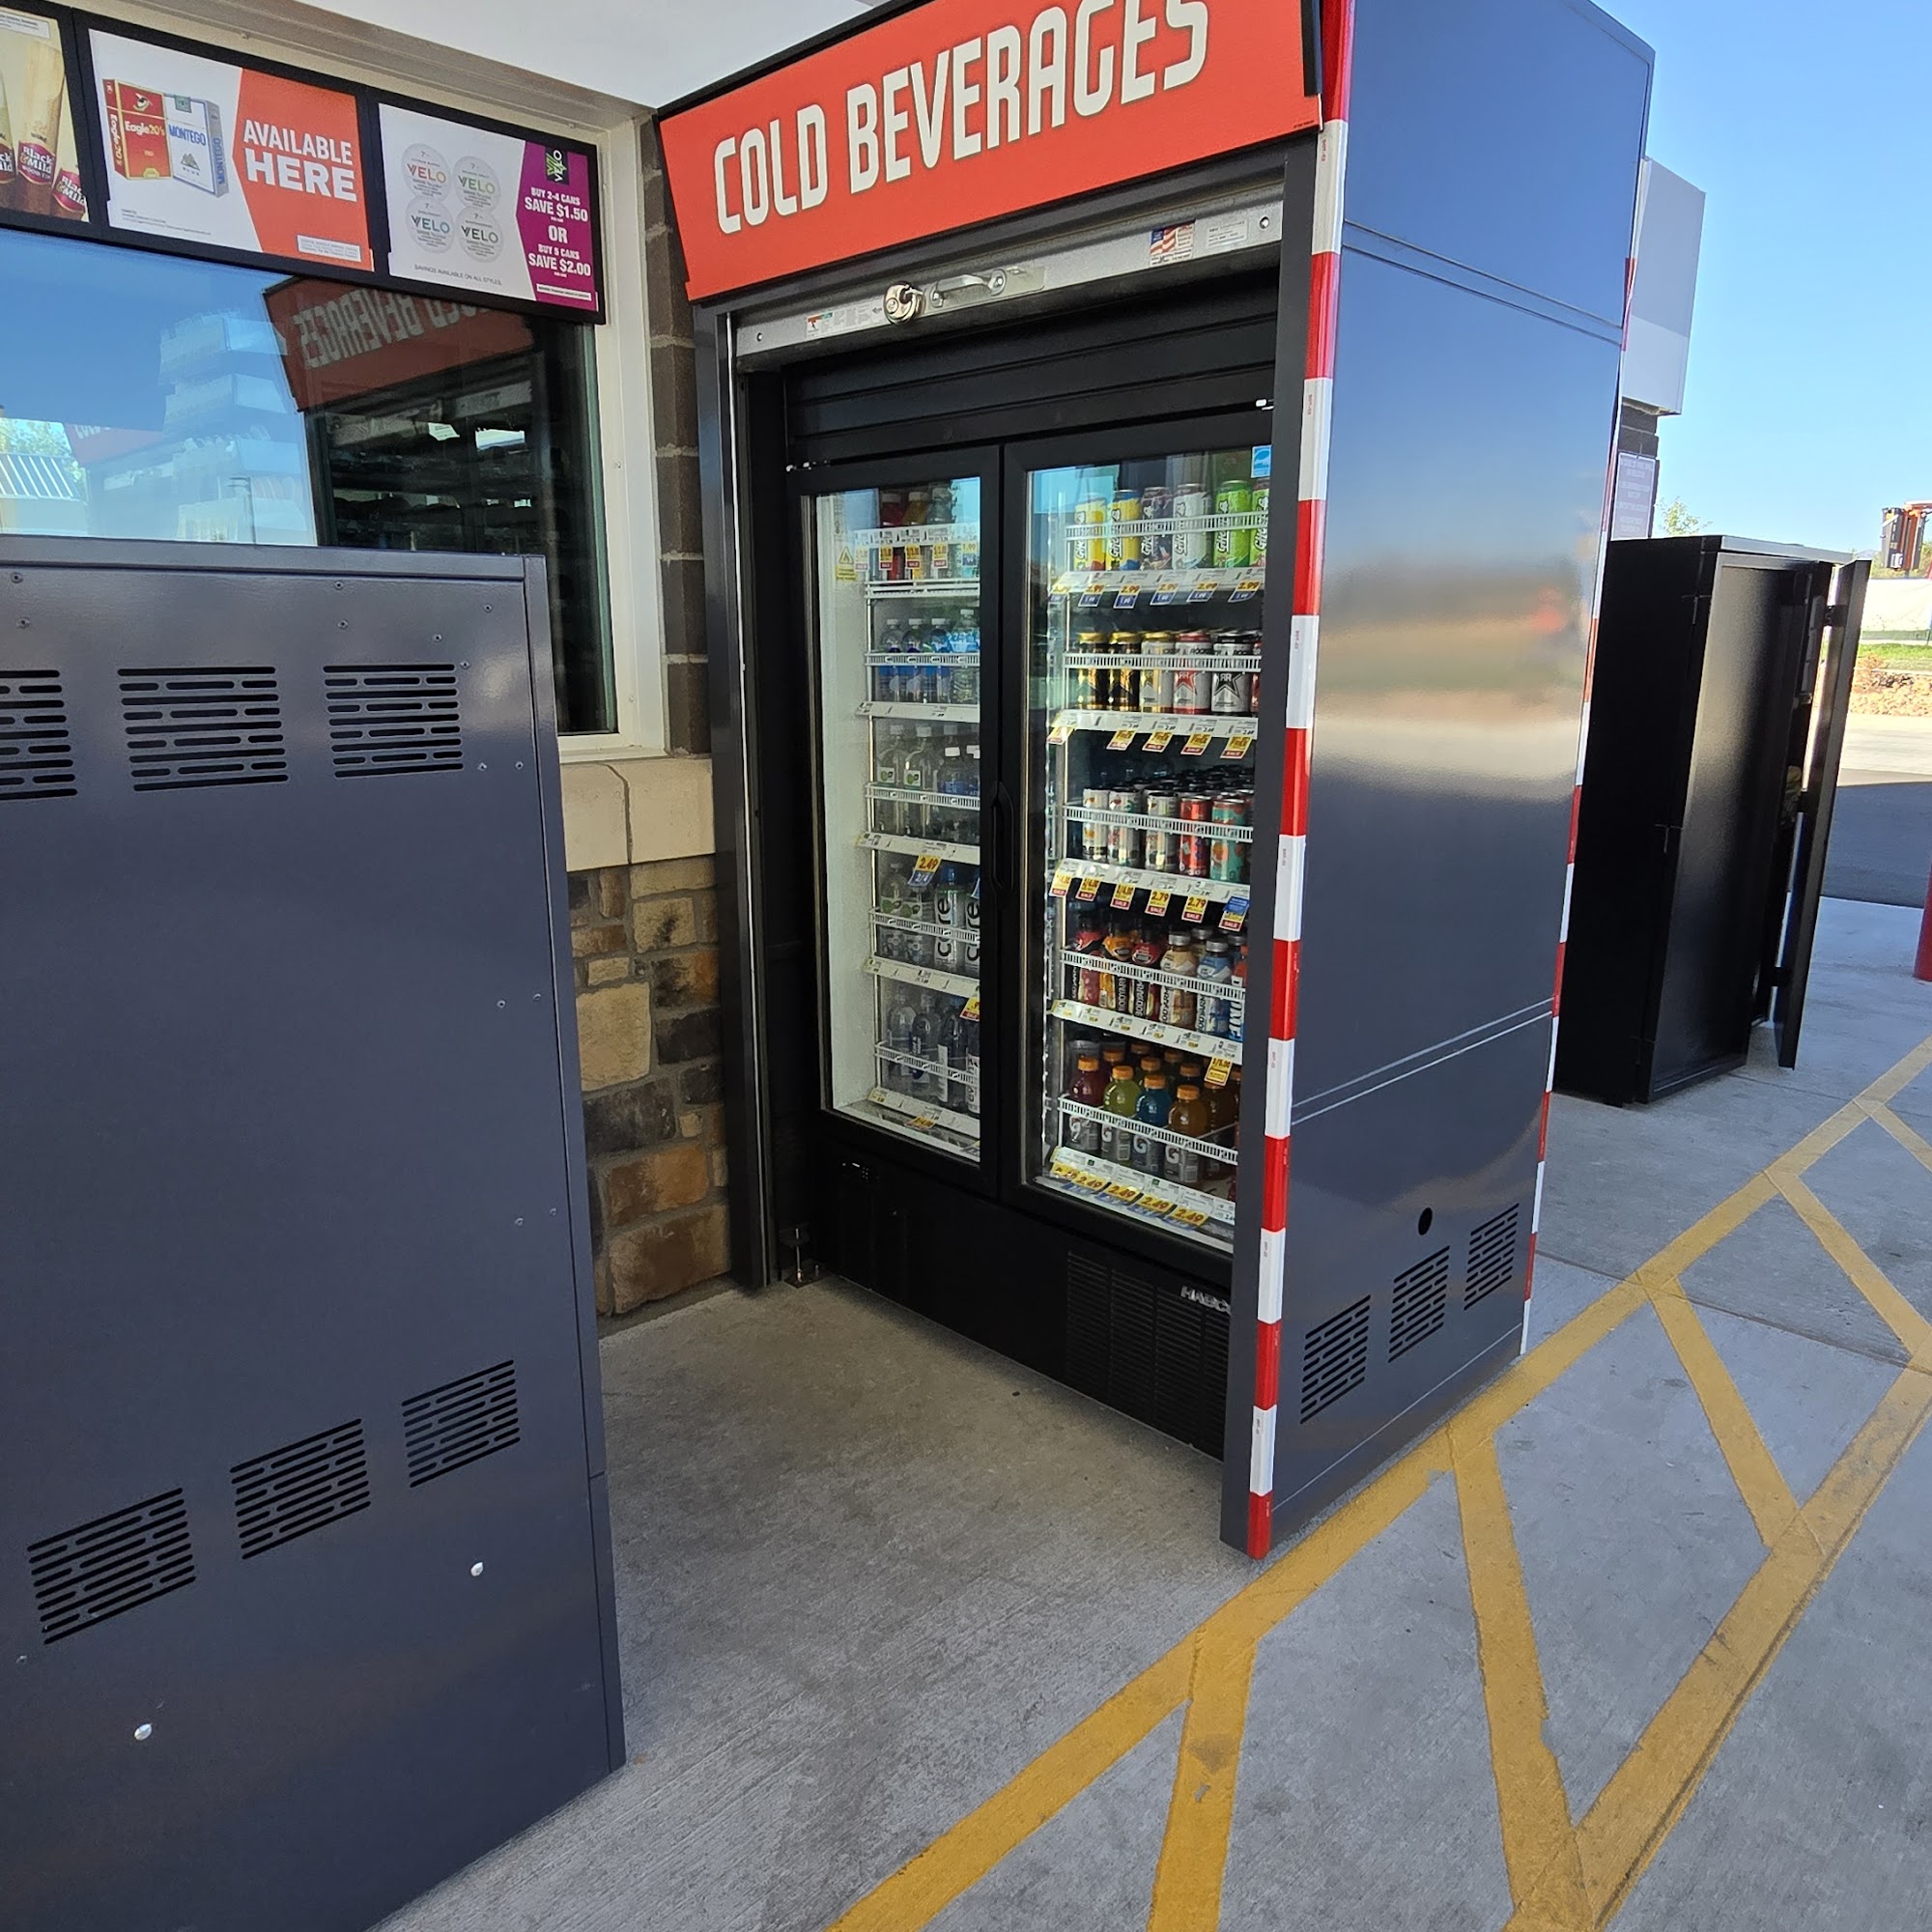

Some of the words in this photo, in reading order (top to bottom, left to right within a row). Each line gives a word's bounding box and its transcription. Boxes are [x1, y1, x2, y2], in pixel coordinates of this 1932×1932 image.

[714, 103, 829, 235] COLD
[846, 0, 1208, 194] BEVERAGES
[168, 125, 207, 146] MONTEGO
[243, 119, 353, 166] AVAILABLE
[23, 146, 53, 164] Black
[27, 157, 52, 174] Mild
[407, 162, 446, 184] VELO
[244, 148, 357, 202] HERE
[458, 175, 496, 194] VELO
[531, 187, 546, 199] BUY
[561, 193, 581, 205] CANS
[525, 196, 554, 214] SAVE
[556, 202, 588, 222] $1.50
[411, 214, 450, 234] VELO
[461, 225, 498, 243] VELO
[548, 225, 568, 243] OR
[538, 243, 553, 255] BUY
[560, 248, 580, 260] CANS
[528, 253, 557, 270] SAVE
[559, 258, 591, 276] $2.00
[919, 858, 938, 870] 2.49
[1151, 891, 1169, 902] 2.79
[1188, 896, 1207, 908] 2.79
[1078, 1173, 1102, 1189] 2.49
[1108, 1182, 1136, 1199] 2.49
[1141, 1196, 1169, 1210] 2.49
[1175, 1208, 1205, 1223] 2.49
